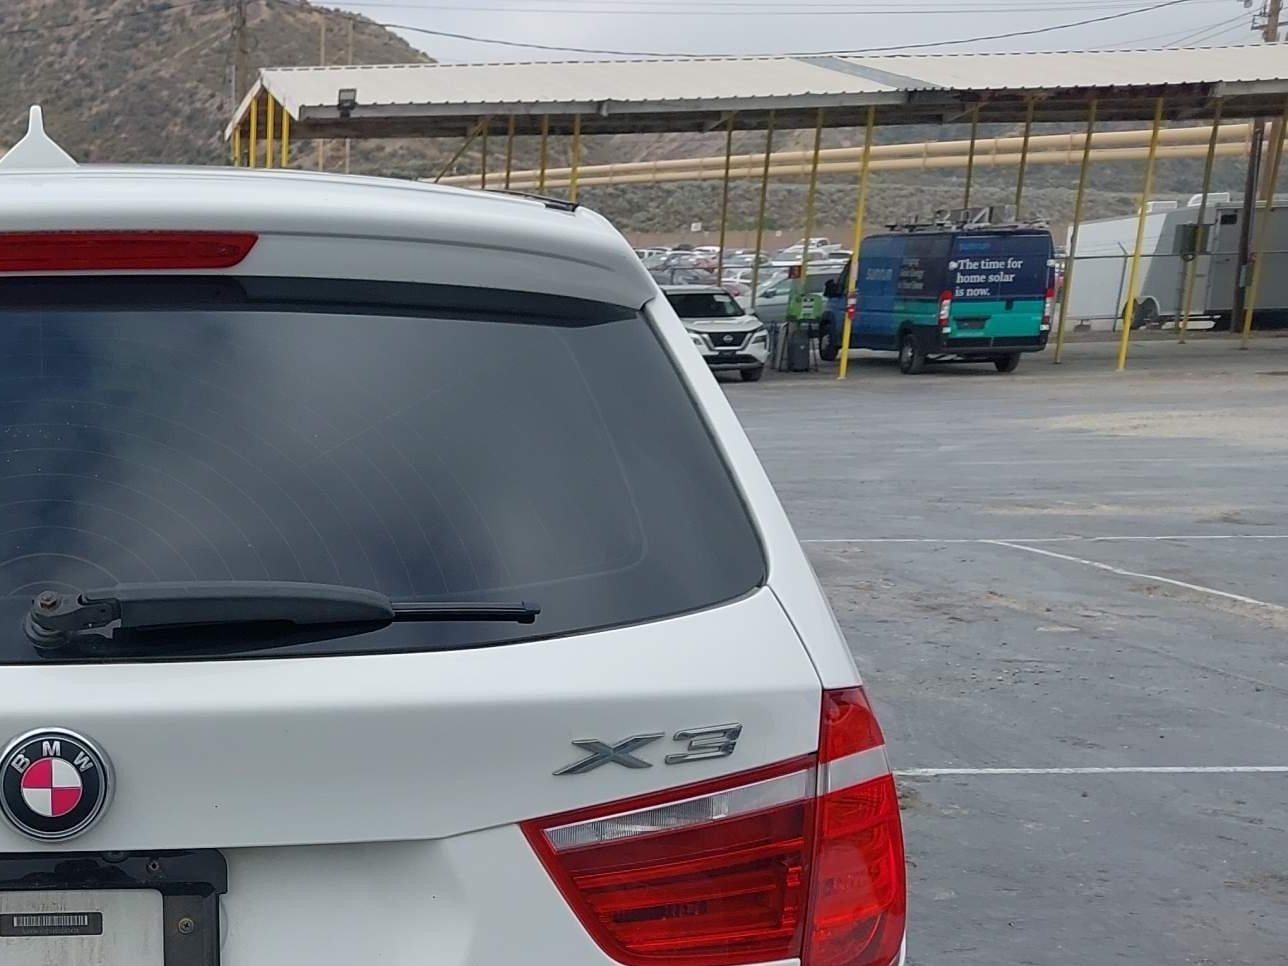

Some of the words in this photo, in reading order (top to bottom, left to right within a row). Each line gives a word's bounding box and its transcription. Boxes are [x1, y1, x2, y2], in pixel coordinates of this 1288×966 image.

[957, 259, 980, 270] The
[981, 258, 1005, 270] time
[1007, 257, 1023, 269] for
[956, 274, 986, 283] home
[988, 272, 1015, 283] solar
[955, 286, 964, 296] is
[966, 287, 990, 296] now.
[552, 722, 743, 776] X3
[11, 740, 94, 774] BMW
